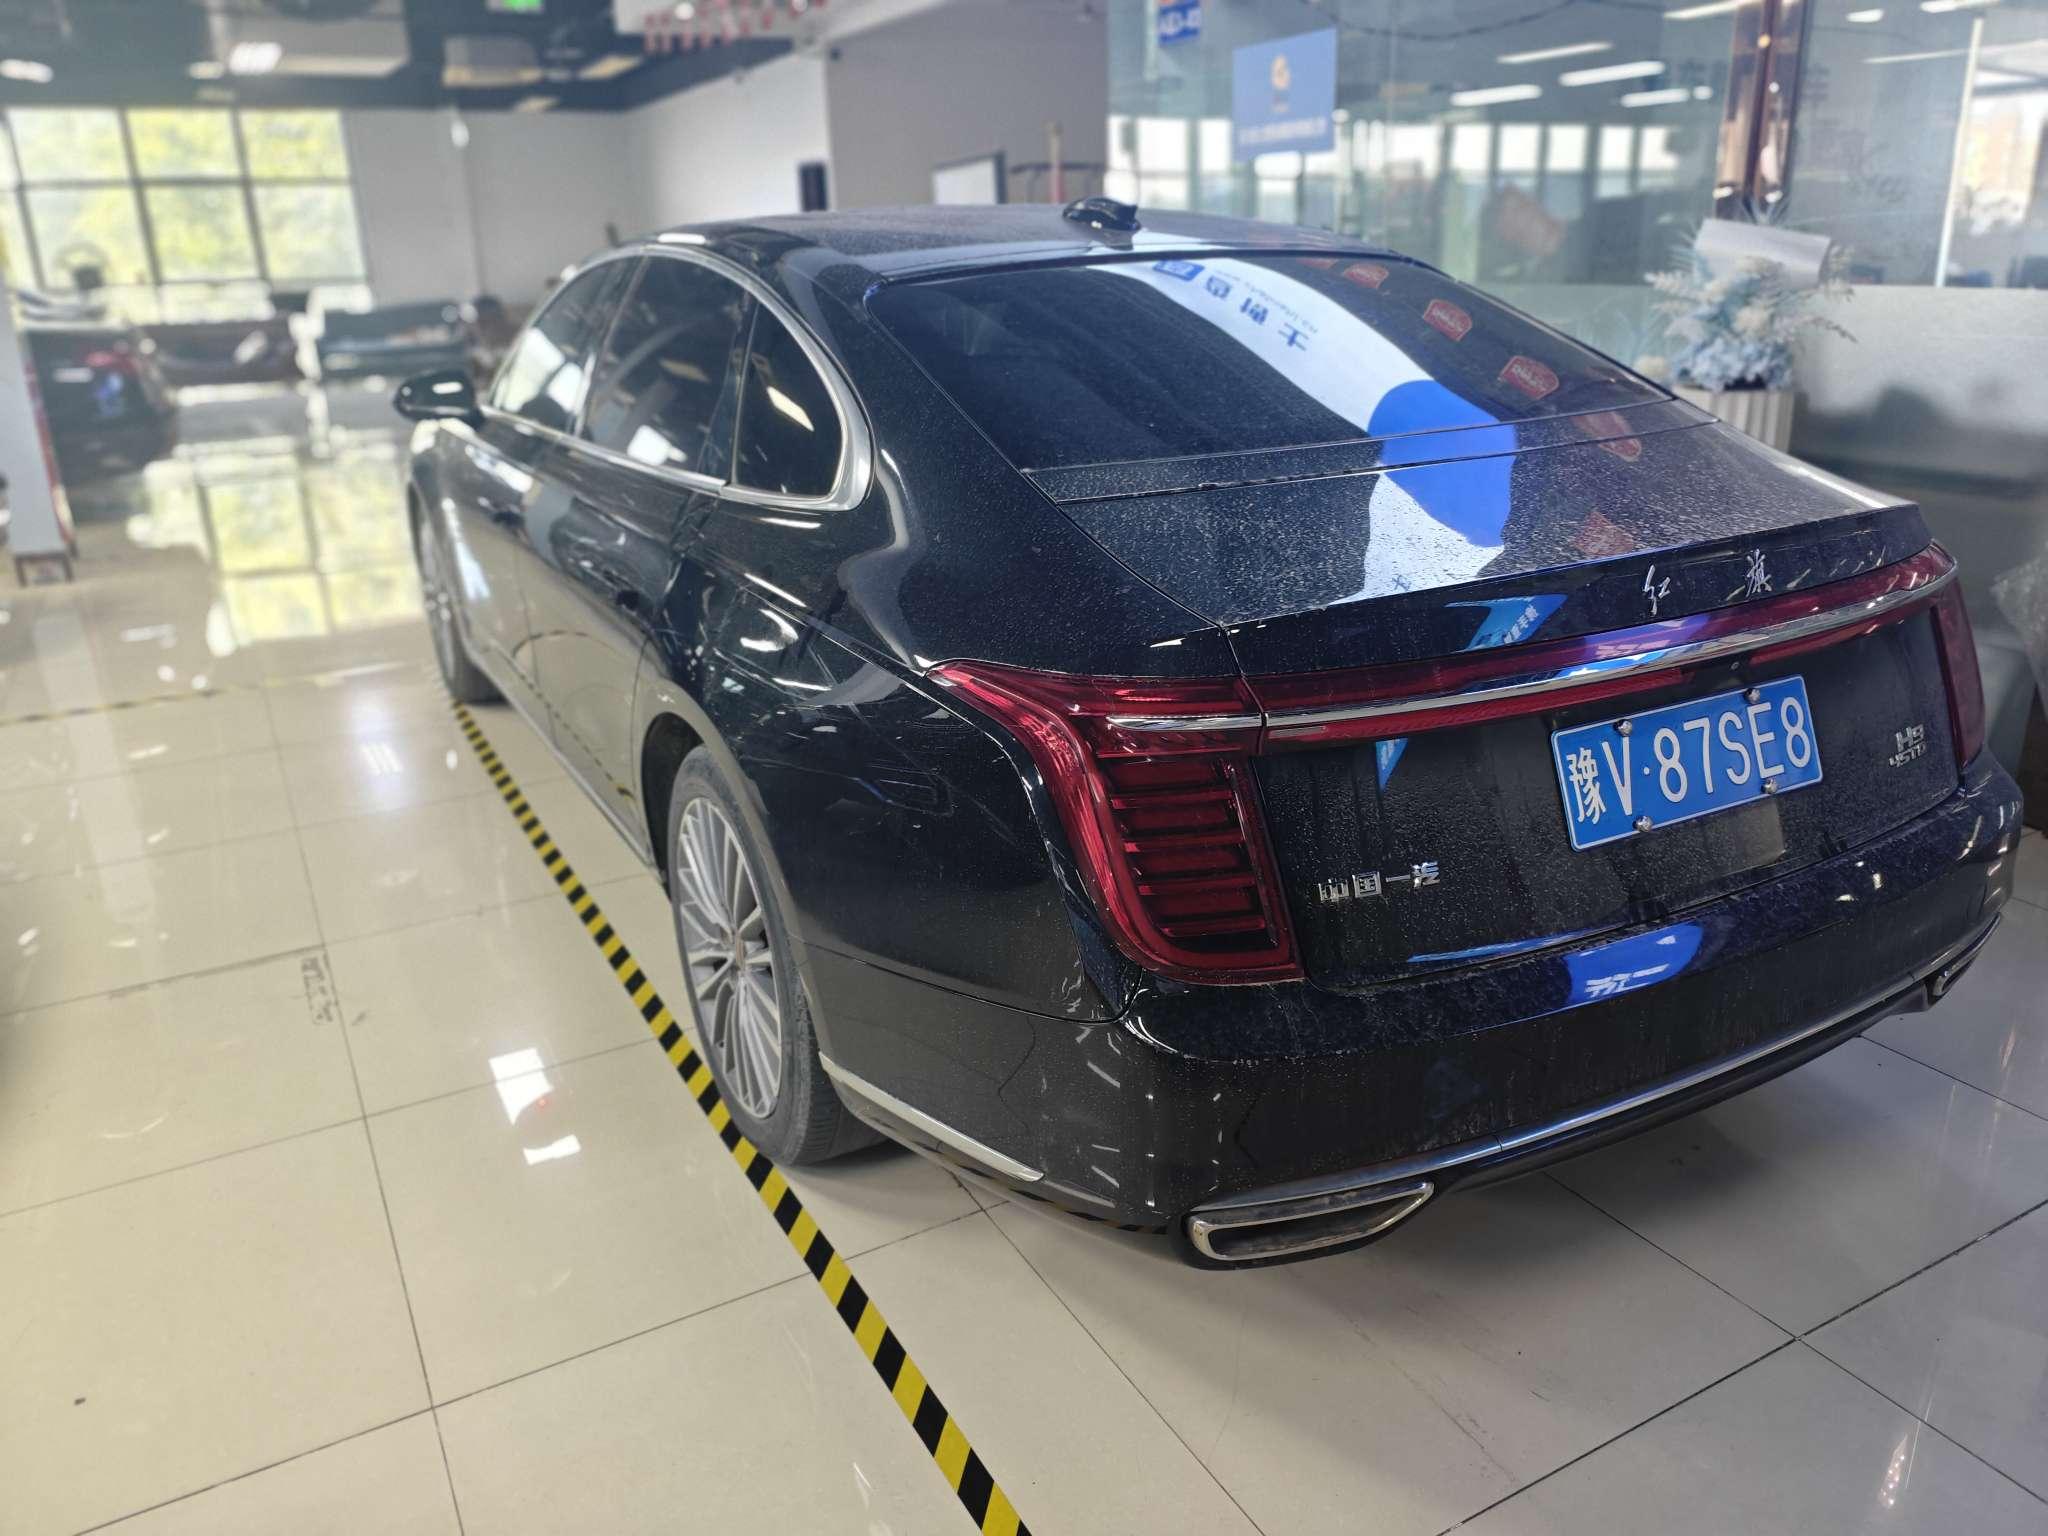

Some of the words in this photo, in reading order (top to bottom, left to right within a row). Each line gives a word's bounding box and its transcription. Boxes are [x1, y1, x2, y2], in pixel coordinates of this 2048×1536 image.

[1895, 724, 1924, 752] H9
[1565, 696, 1811, 825] 豫V·87SE8
[1318, 861, 1441, 902] 中国一汽
